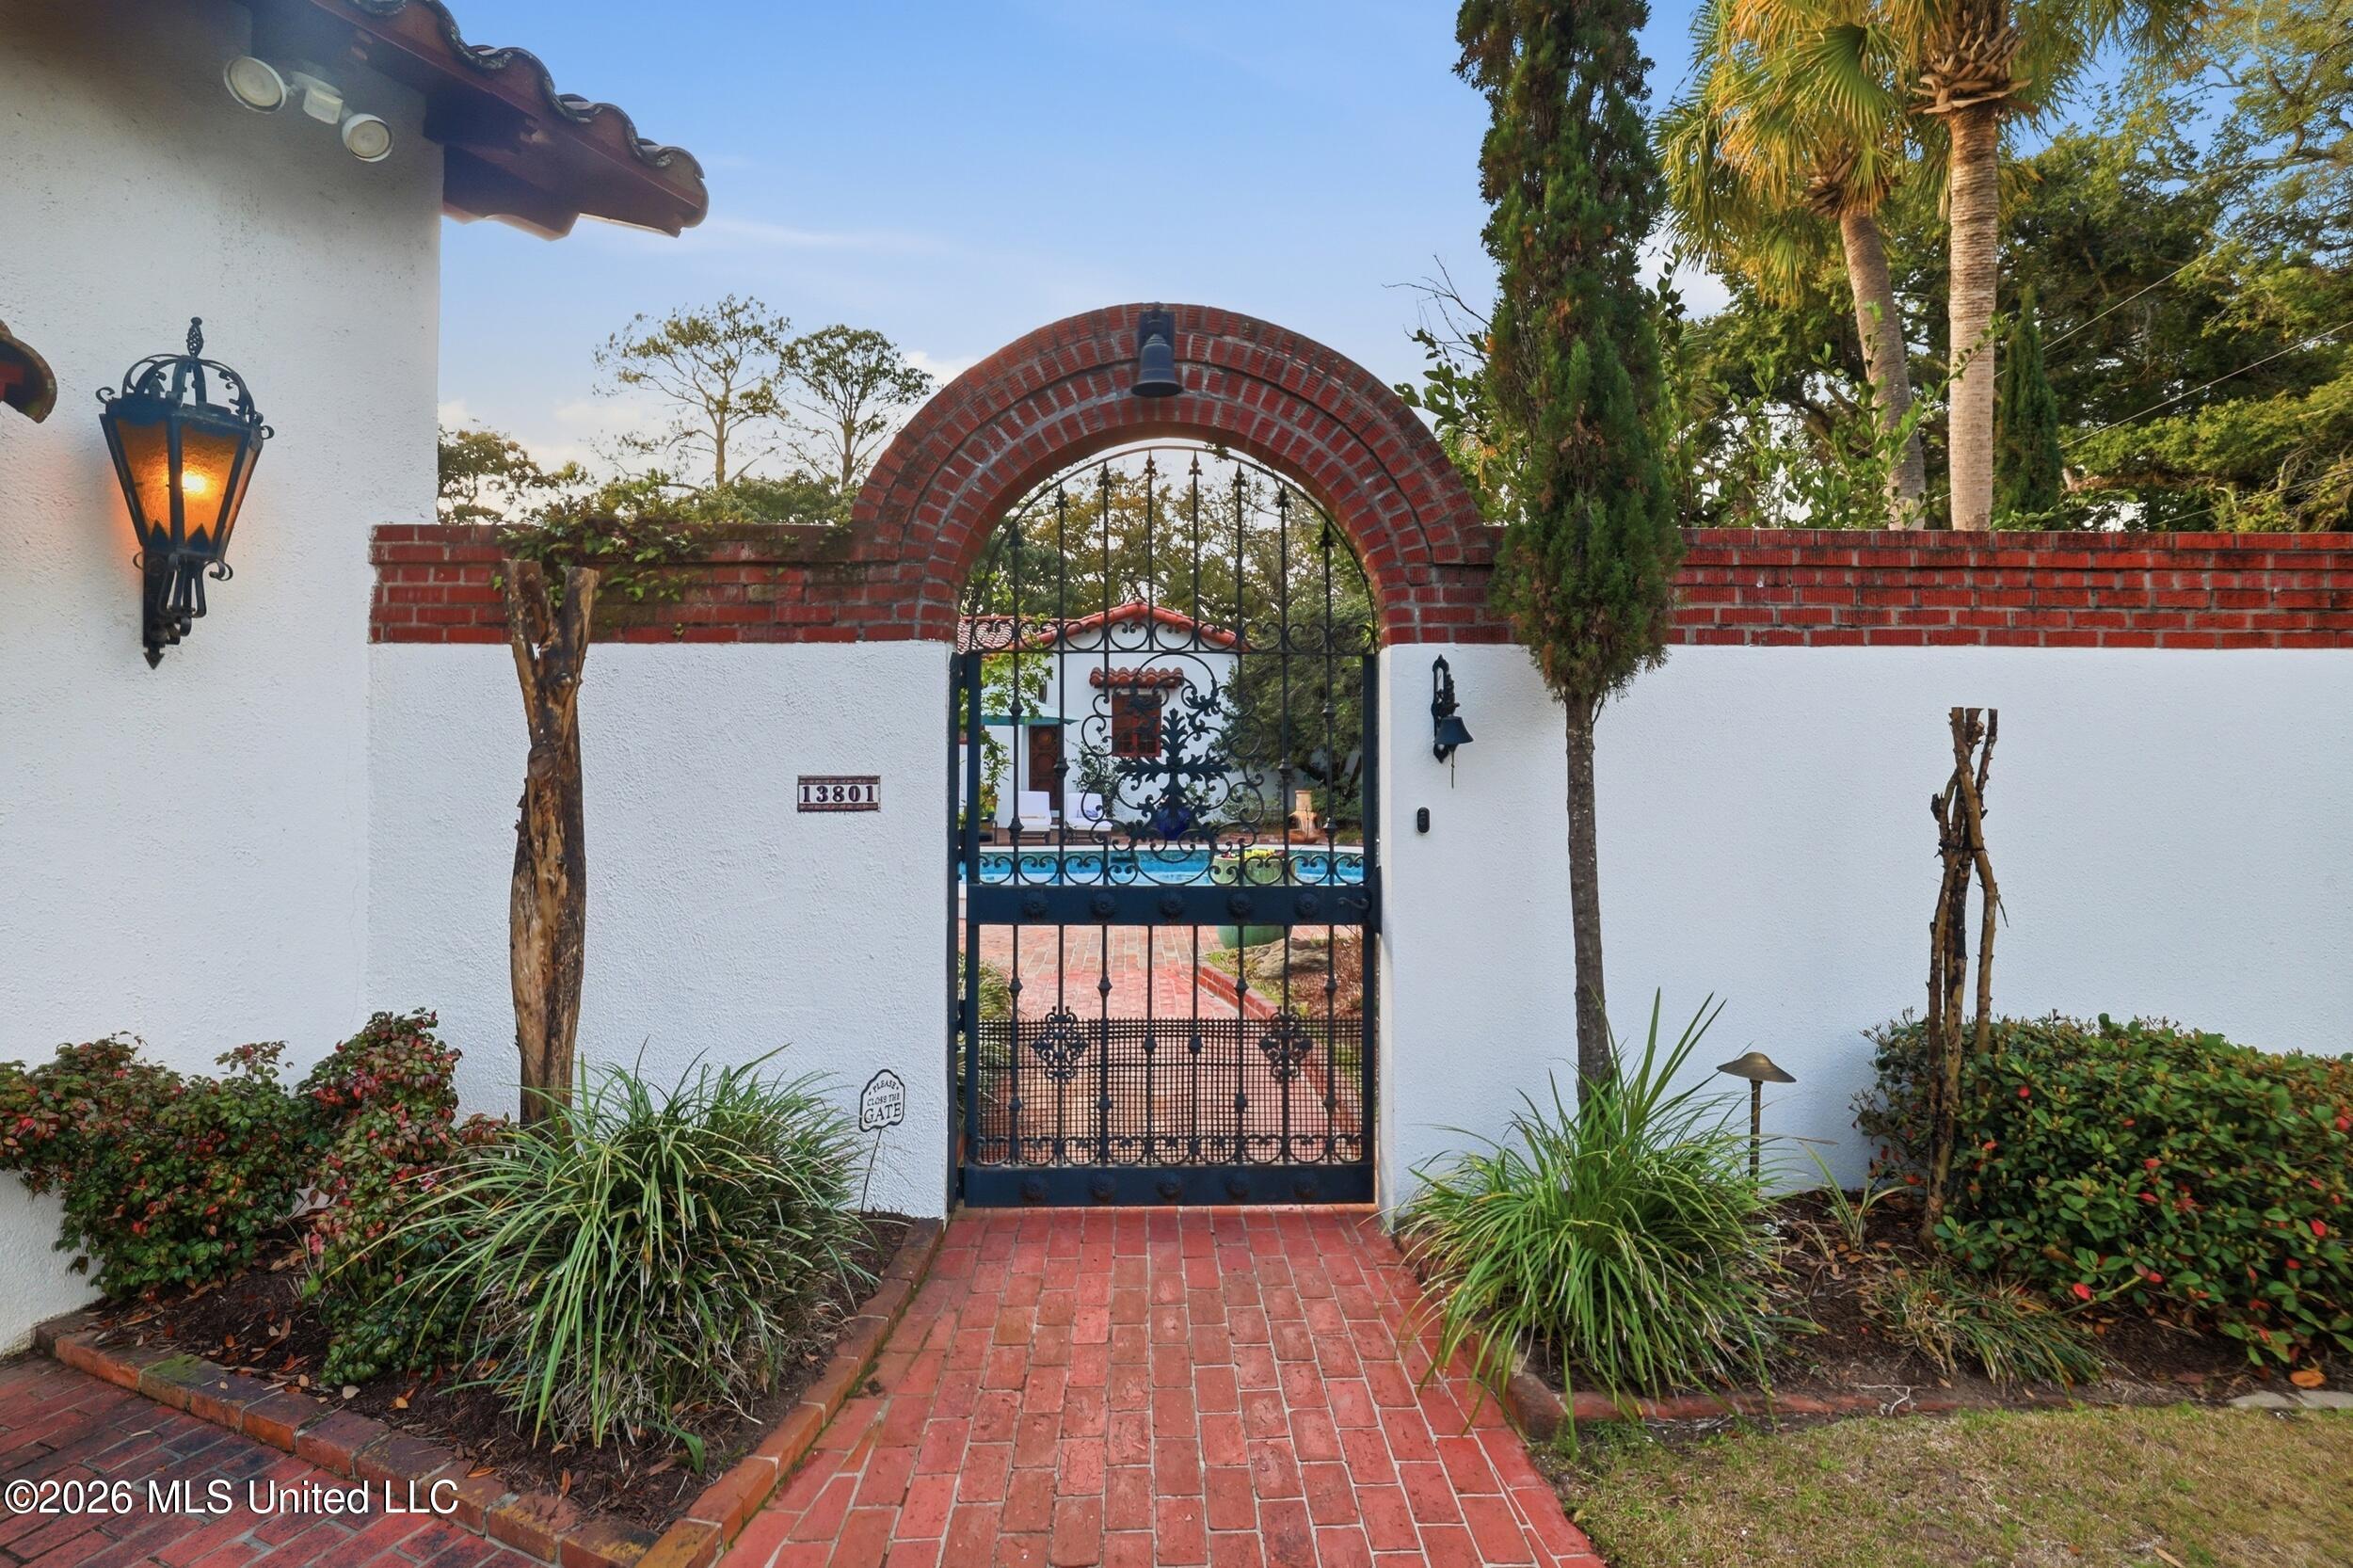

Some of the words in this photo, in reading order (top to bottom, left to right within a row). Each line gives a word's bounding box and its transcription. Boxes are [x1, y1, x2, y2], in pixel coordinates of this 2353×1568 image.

[803, 785, 874, 803] 13801
[872, 1080, 897, 1093] PLEASE
[888, 1092, 900, 1102] THE
[864, 1102, 902, 1124] GATE
